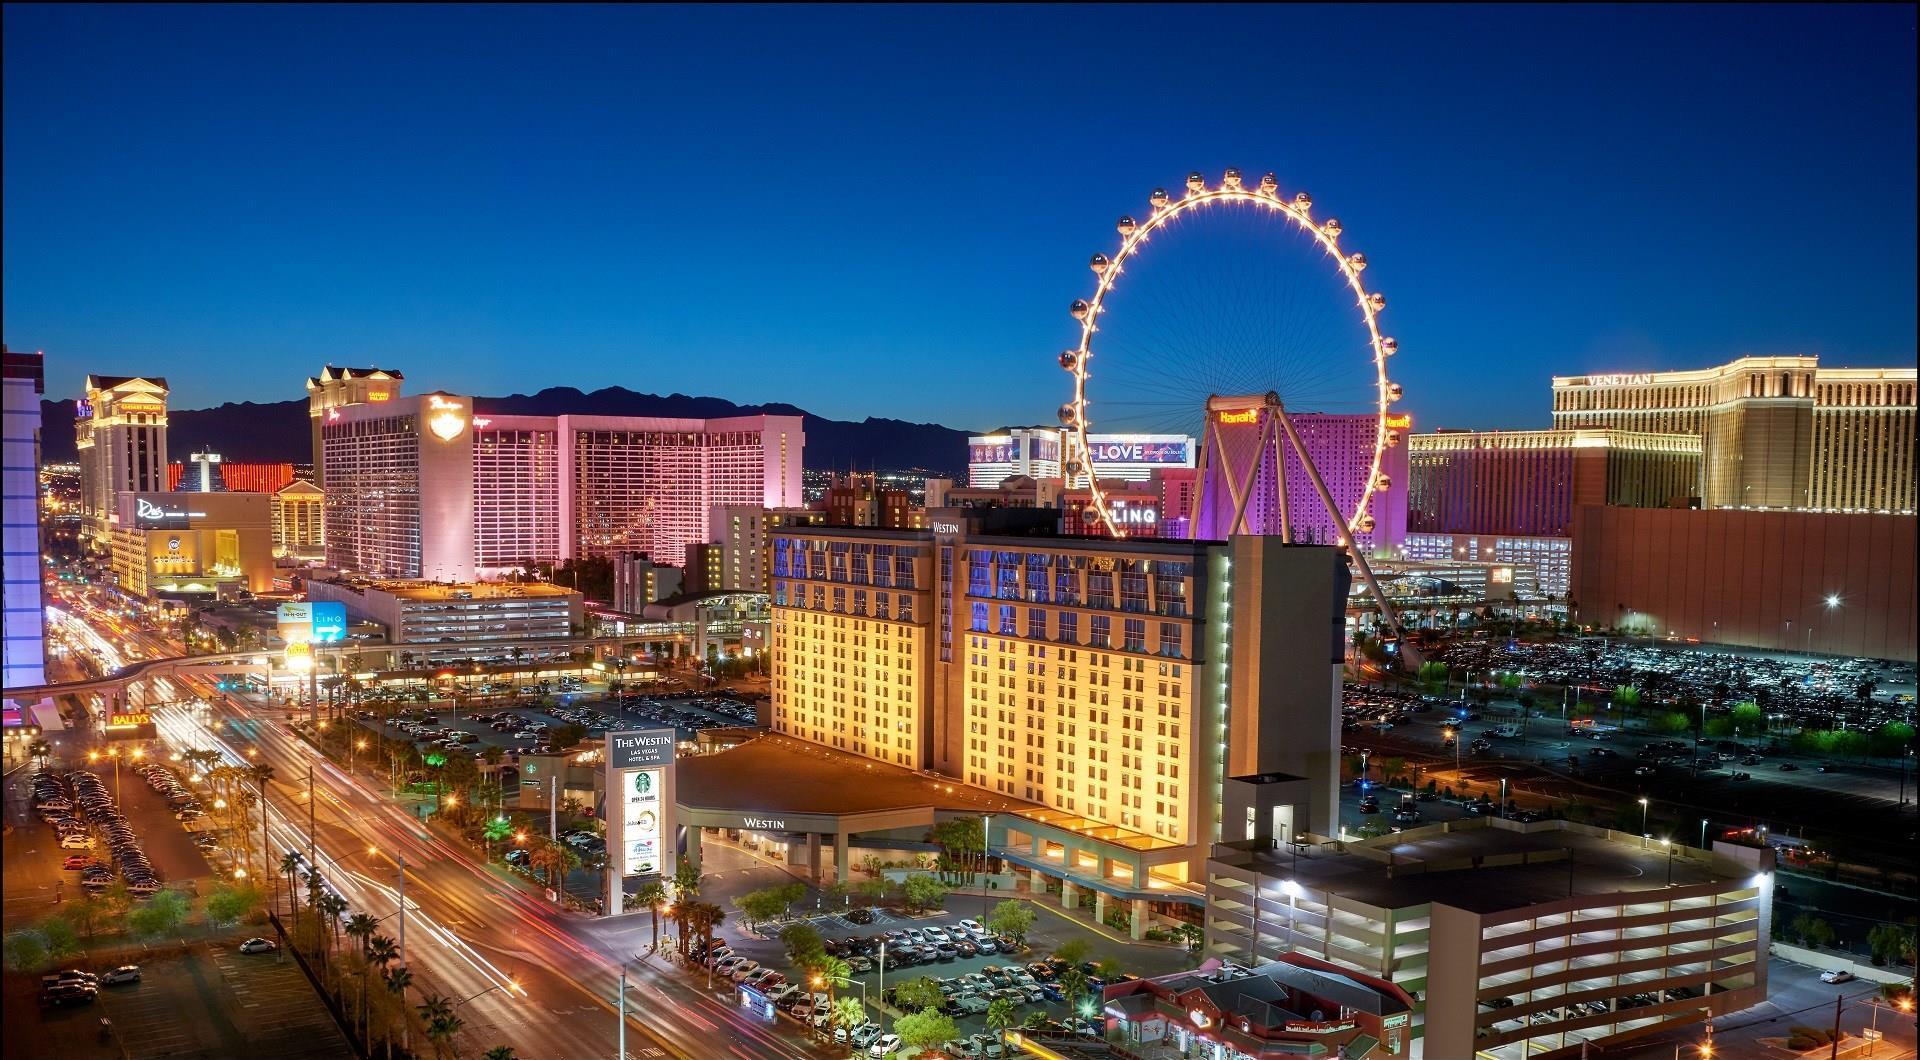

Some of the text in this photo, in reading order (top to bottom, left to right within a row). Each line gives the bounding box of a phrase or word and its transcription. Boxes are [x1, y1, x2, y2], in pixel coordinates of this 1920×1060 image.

[1589, 374, 1652, 386] VENETIAN
[1098, 445, 1143, 460] LOVE
[1112, 509, 1156, 523] LINQ
[615, 736, 671, 749] THE WESTIN
[744, 817, 785, 829] WESTIN
